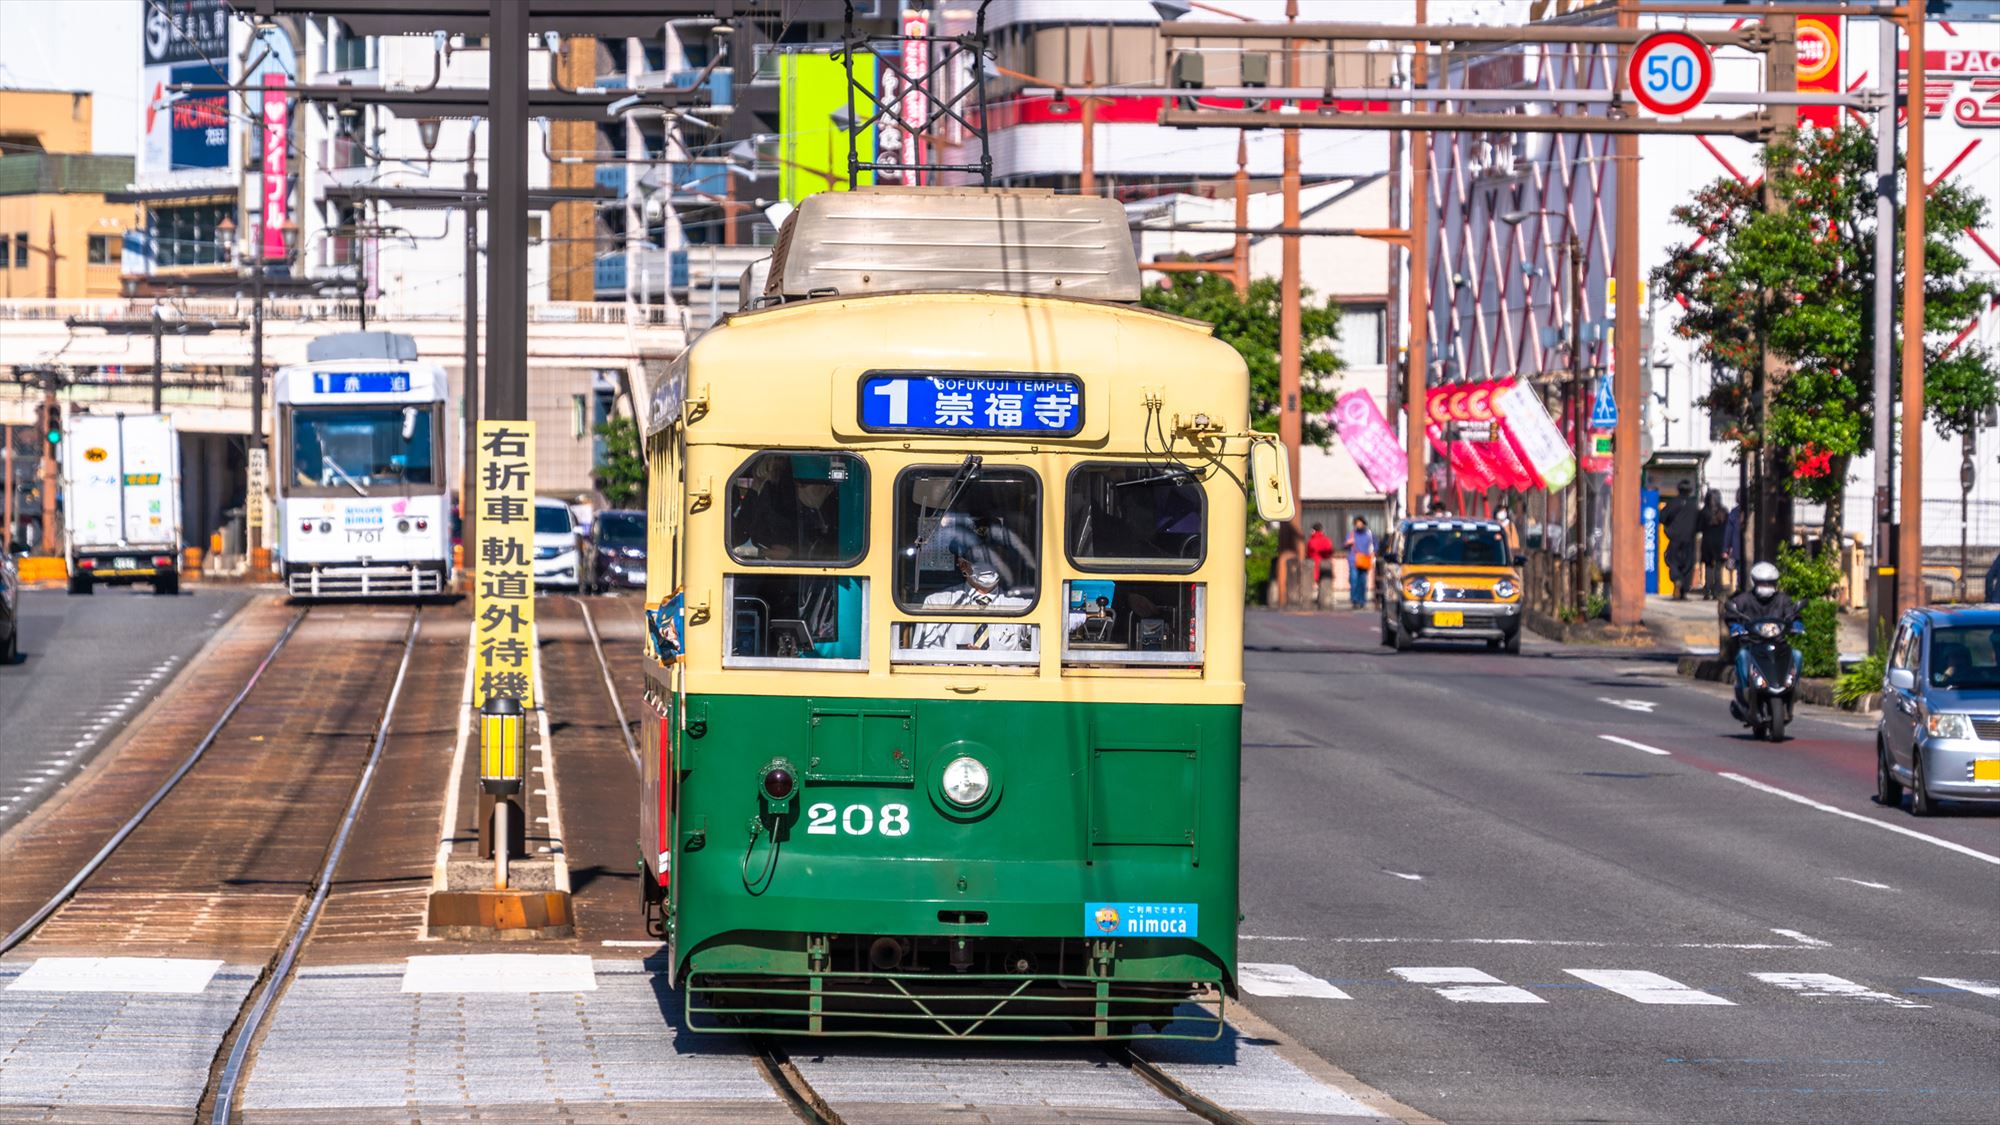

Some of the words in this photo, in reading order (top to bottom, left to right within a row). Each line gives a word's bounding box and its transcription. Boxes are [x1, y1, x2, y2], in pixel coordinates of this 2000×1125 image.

[1647, 54, 1694, 92] 50
[1944, 51, 2000, 71] PAC
[266, 123, 285, 230] アイフル
[318, 373, 331, 393] 1
[937, 379, 1010, 391] SOFUKUJI
[1015, 381, 1073, 392] TEMPLE
[874, 379, 909, 425] 1
[935, 392, 1072, 428] 崇福寺
[482, 427, 531, 525] 右折車
[346, 529, 382, 543] 1701
[479, 536, 532, 703] 軌道外待機
[807, 803, 911, 837] 208
[1127, 914, 1187, 933] nimoca
